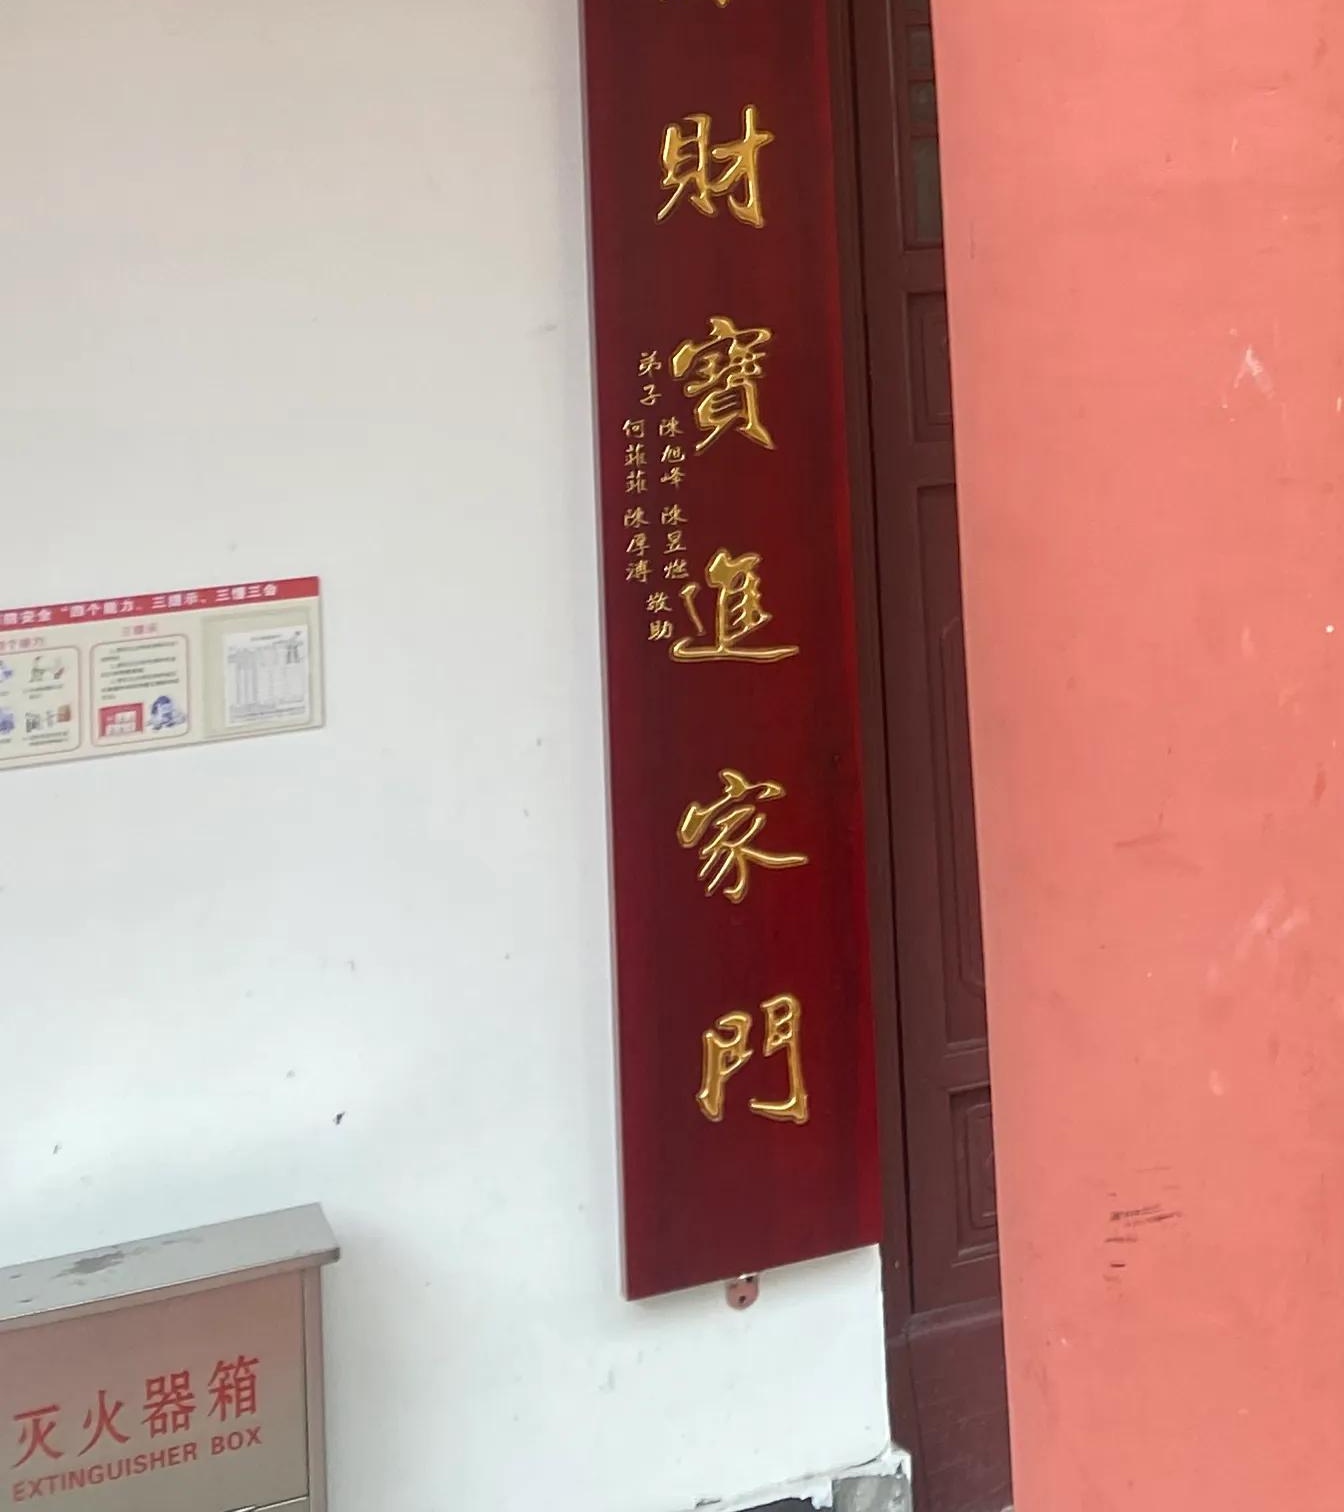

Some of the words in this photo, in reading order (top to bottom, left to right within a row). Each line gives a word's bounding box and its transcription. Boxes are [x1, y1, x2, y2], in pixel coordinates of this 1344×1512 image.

[638, 351, 662, 406] 弟子
[10, 1354, 260, 1470] 灭火器箱
[12, 1441, 199, 1503] EXTINGUISHER
[210, 1425, 263, 1456] BOX
